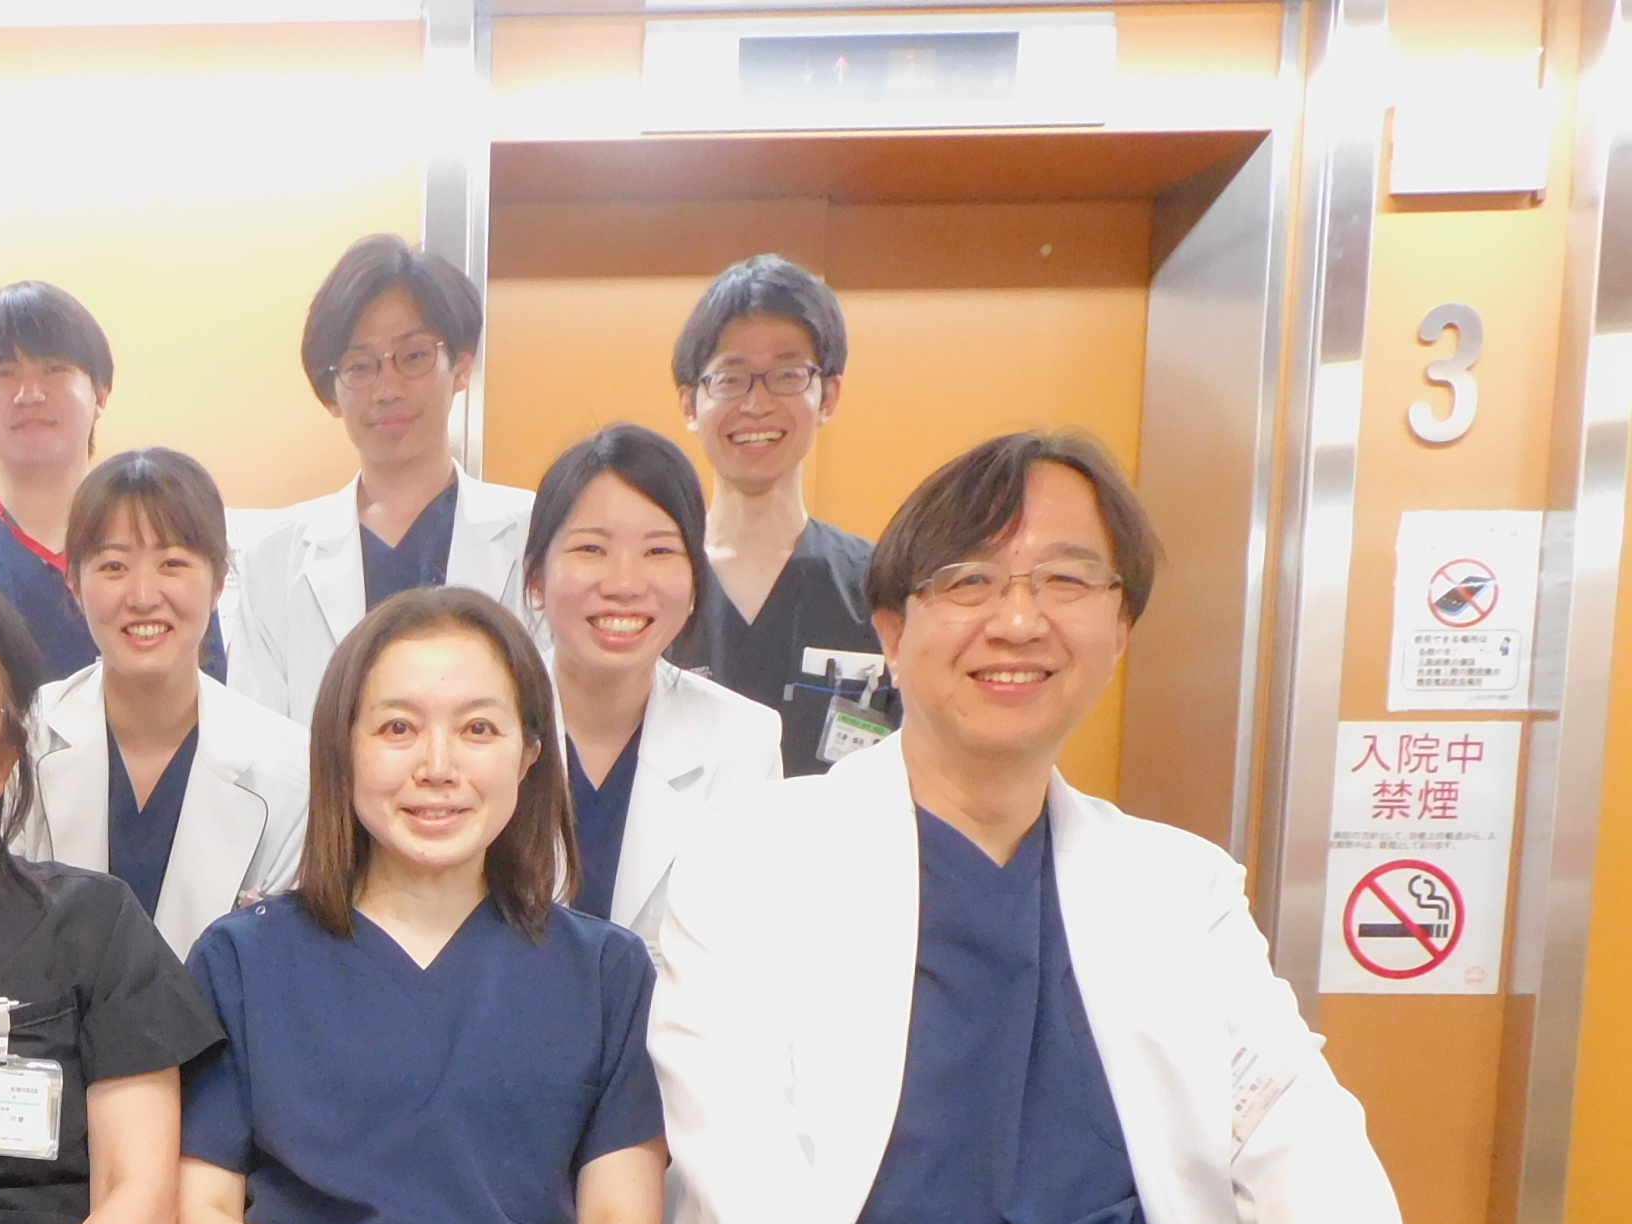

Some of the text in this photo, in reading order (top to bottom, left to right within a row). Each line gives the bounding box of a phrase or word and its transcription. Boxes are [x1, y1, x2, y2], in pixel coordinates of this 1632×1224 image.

[1408, 303, 1484, 443] 3
[1351, 732, 1485, 774] 入院中
[1372, 779, 1460, 820] 禁煙
